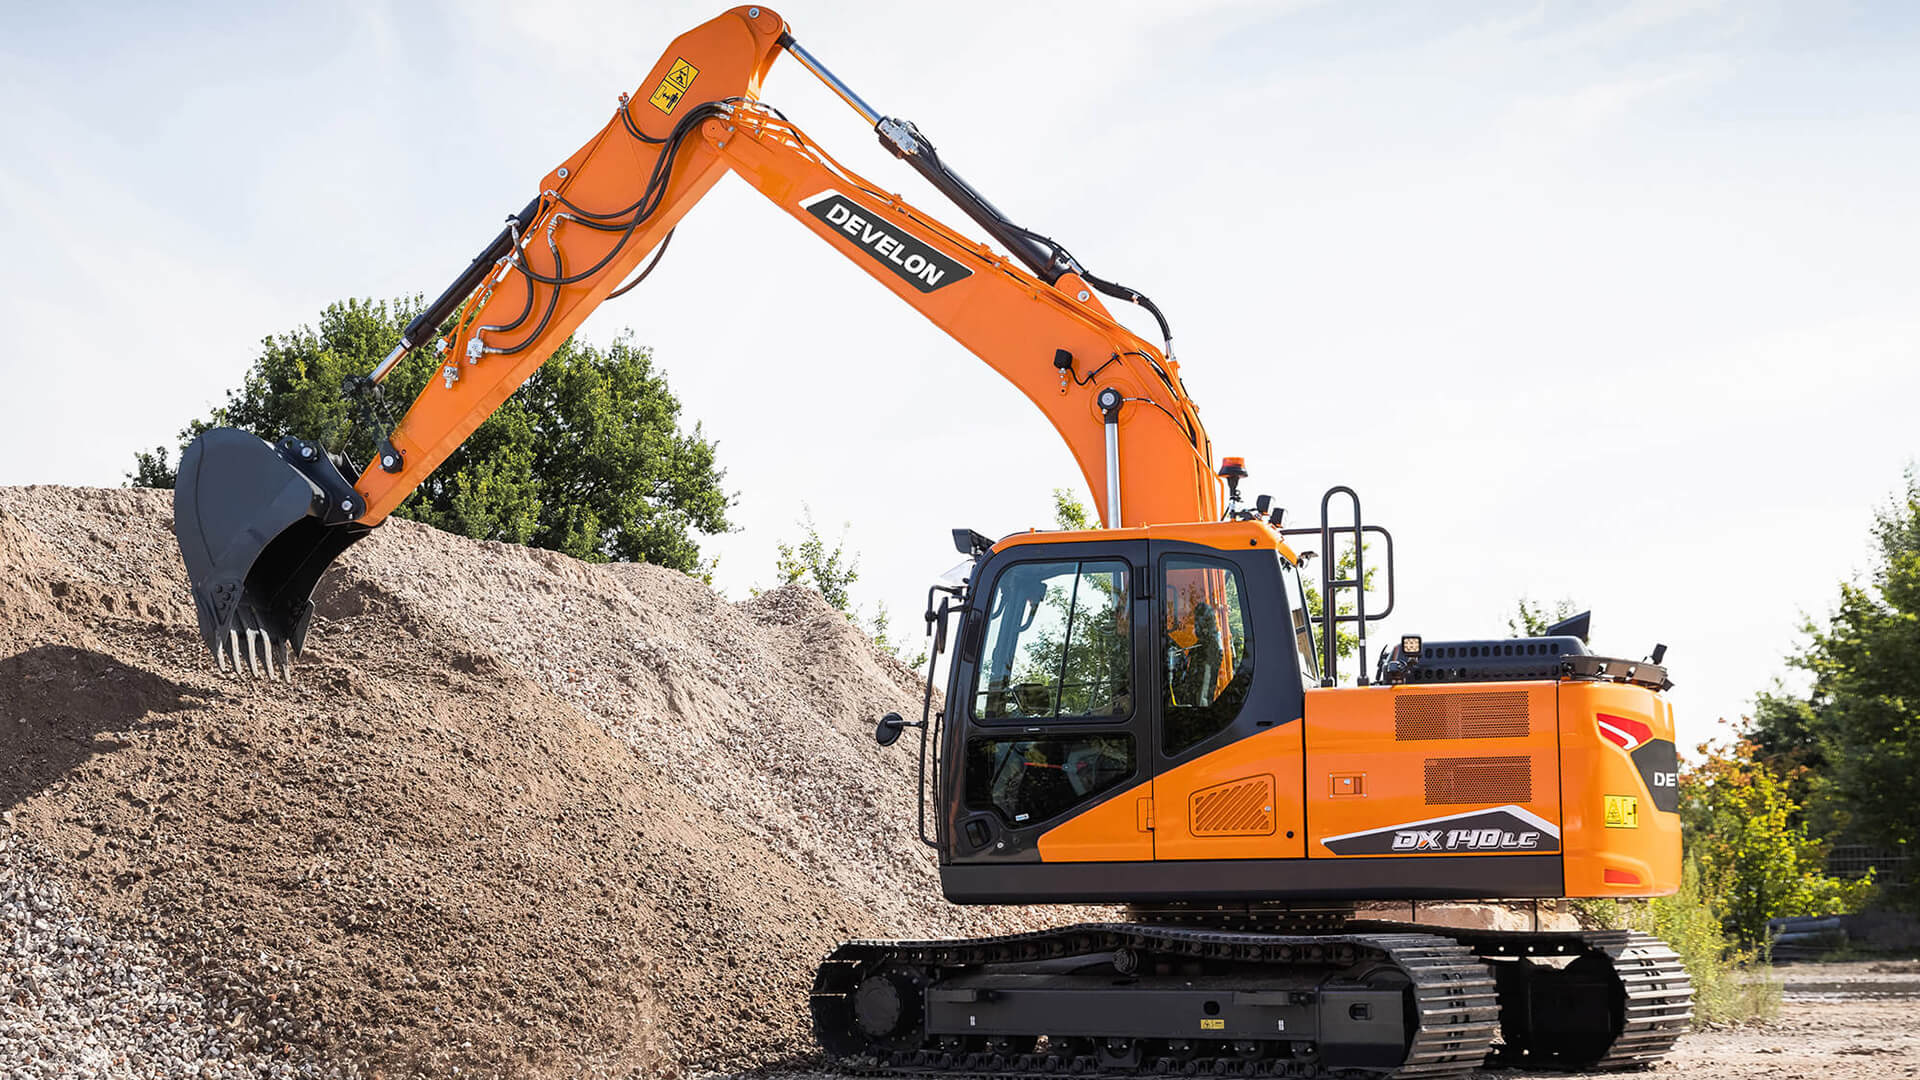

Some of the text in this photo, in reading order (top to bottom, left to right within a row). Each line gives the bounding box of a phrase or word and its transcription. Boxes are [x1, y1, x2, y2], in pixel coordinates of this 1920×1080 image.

[825, 203, 945, 287] DEVELON
[1654, 771, 1679, 787] DE
[1392, 830, 1443, 851] DX
